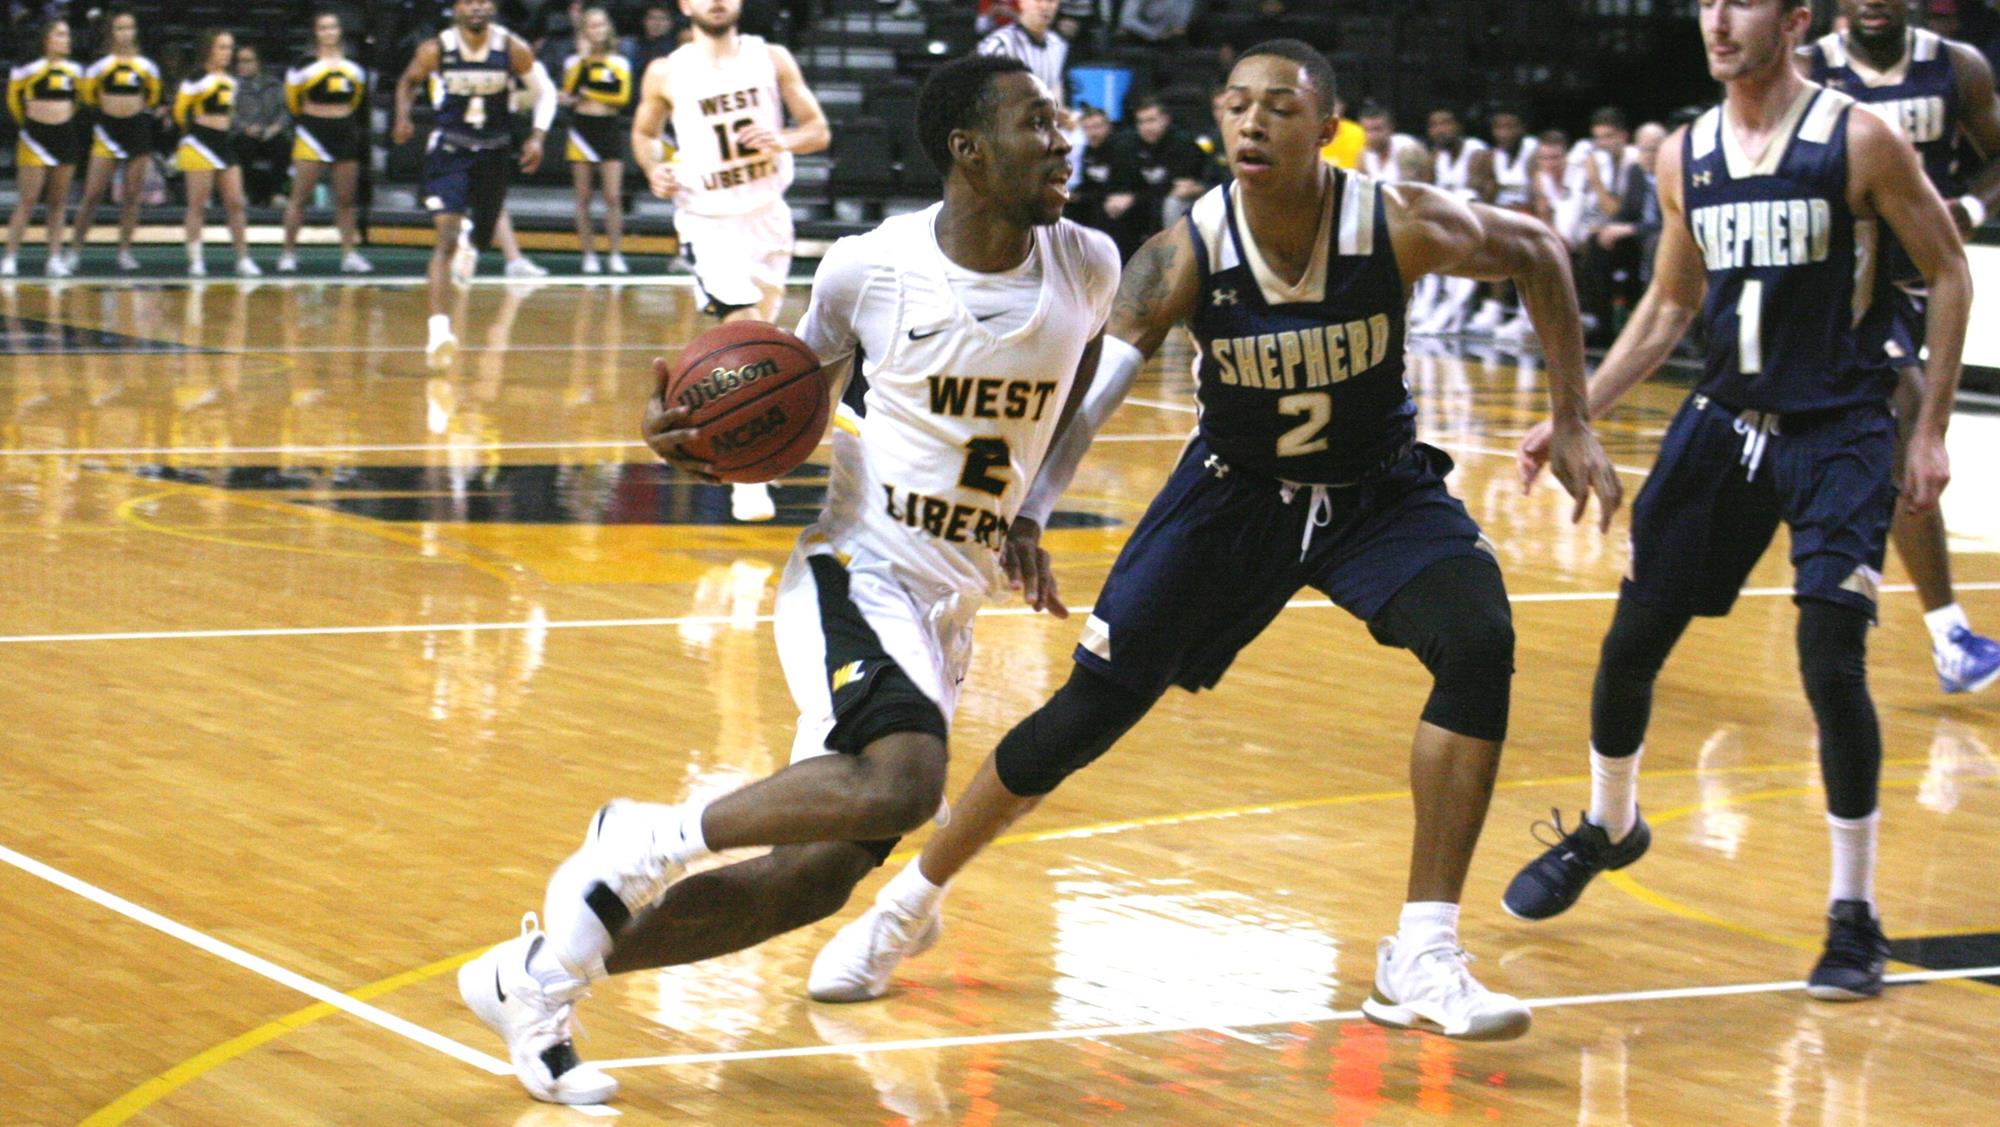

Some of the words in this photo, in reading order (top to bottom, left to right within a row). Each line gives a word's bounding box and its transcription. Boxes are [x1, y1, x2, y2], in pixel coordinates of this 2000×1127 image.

[463, 96, 487, 130] 4
[698, 87, 759, 117] WEST
[1691, 198, 1831, 271] SHEPHERD
[1211, 312, 1389, 390] SHEPHERD
[1736, 279, 1763, 375] 1
[678, 358, 780, 414] Wilson
[927, 375, 1058, 421] WEST
[711, 404, 788, 455] NCAA
[1276, 391, 1332, 458] 2
[956, 434, 1012, 498] 2
